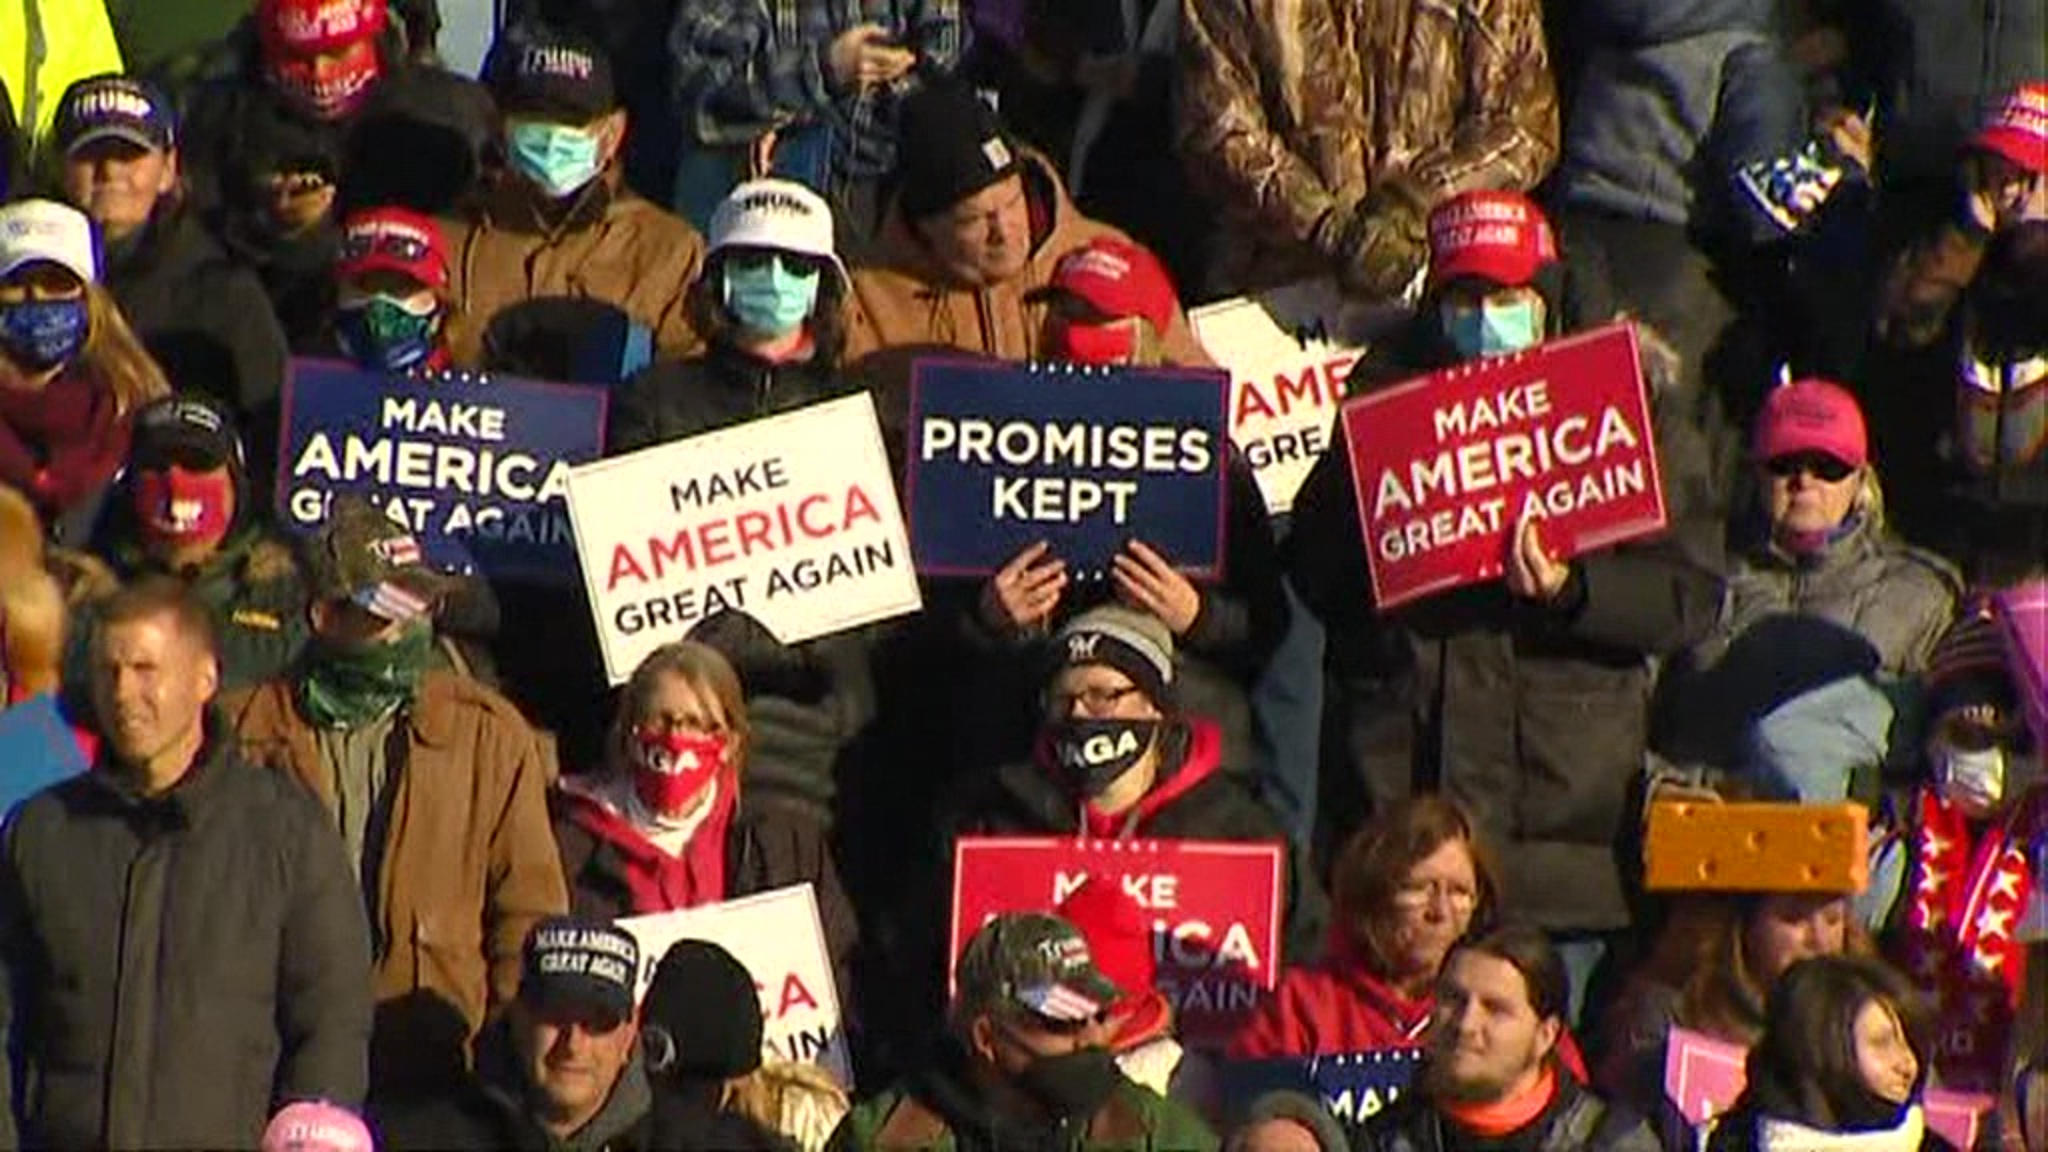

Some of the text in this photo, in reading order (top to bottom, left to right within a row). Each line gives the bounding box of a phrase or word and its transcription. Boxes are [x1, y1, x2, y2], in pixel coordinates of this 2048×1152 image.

[383, 397, 505, 441] MAKE
[1433, 380, 1552, 444] MAKE
[294, 431, 569, 504] AMERICA
[921, 417, 1212, 473] PROMISES
[1245, 424, 1322, 471] GRE
[1374, 404, 1638, 521] AMERICA
[291, 489, 435, 533] GAT
[670, 457, 790, 513] MAKE
[993, 476, 1138, 524] KEPT
[1380, 459, 1645, 563] GREAT AGAIN
[606, 483, 882, 592] AMERICA
[615, 538, 895, 635] GREAT AGAIN
[1053, 871, 1179, 908] MKE
[537, 929, 636, 965] MAKE AMERICA
[541, 951, 591, 975] GREAT
